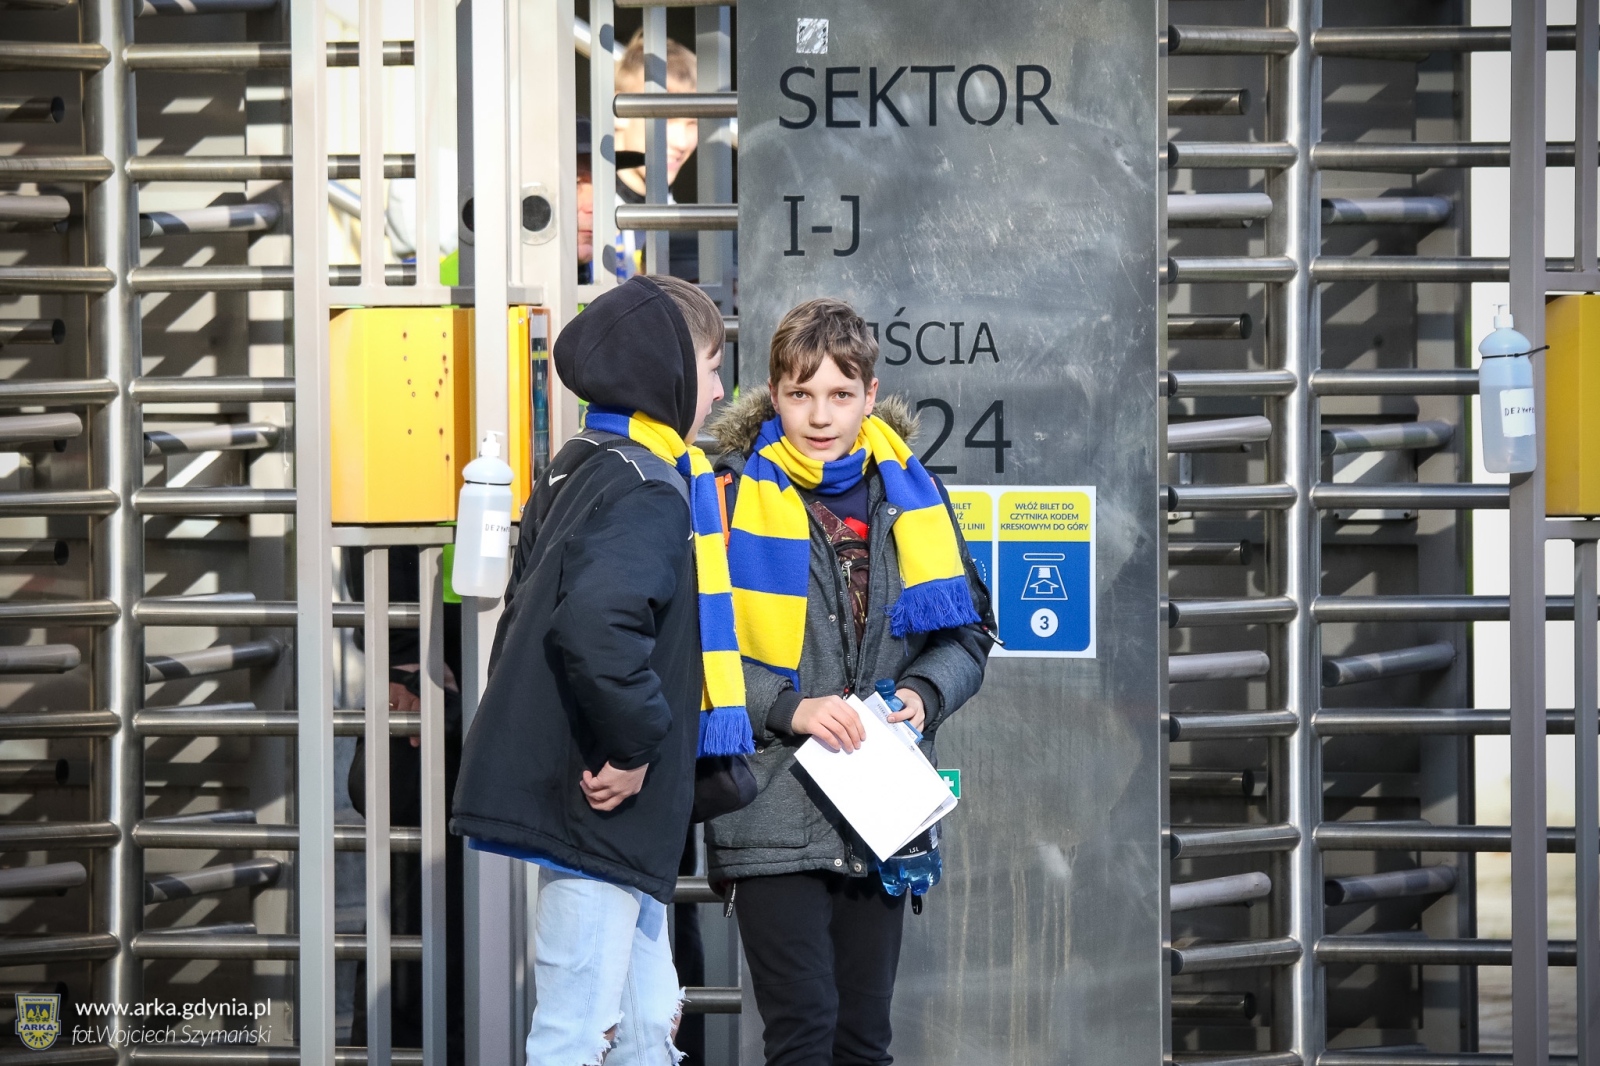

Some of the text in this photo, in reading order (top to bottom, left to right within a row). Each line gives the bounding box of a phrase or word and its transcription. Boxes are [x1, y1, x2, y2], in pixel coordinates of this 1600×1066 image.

[779, 64, 1060, 130] SEKTOR
[783, 194, 861, 257] I-J
[1015, 501, 1075, 510] WŁÓŻ BILET DO
[1009, 513, 1079, 521] CZYTNIKA KODEM
[1000, 521, 1089, 531] KRESKOWYM DO GÓRY
[1039, 615, 1050, 630] 3
